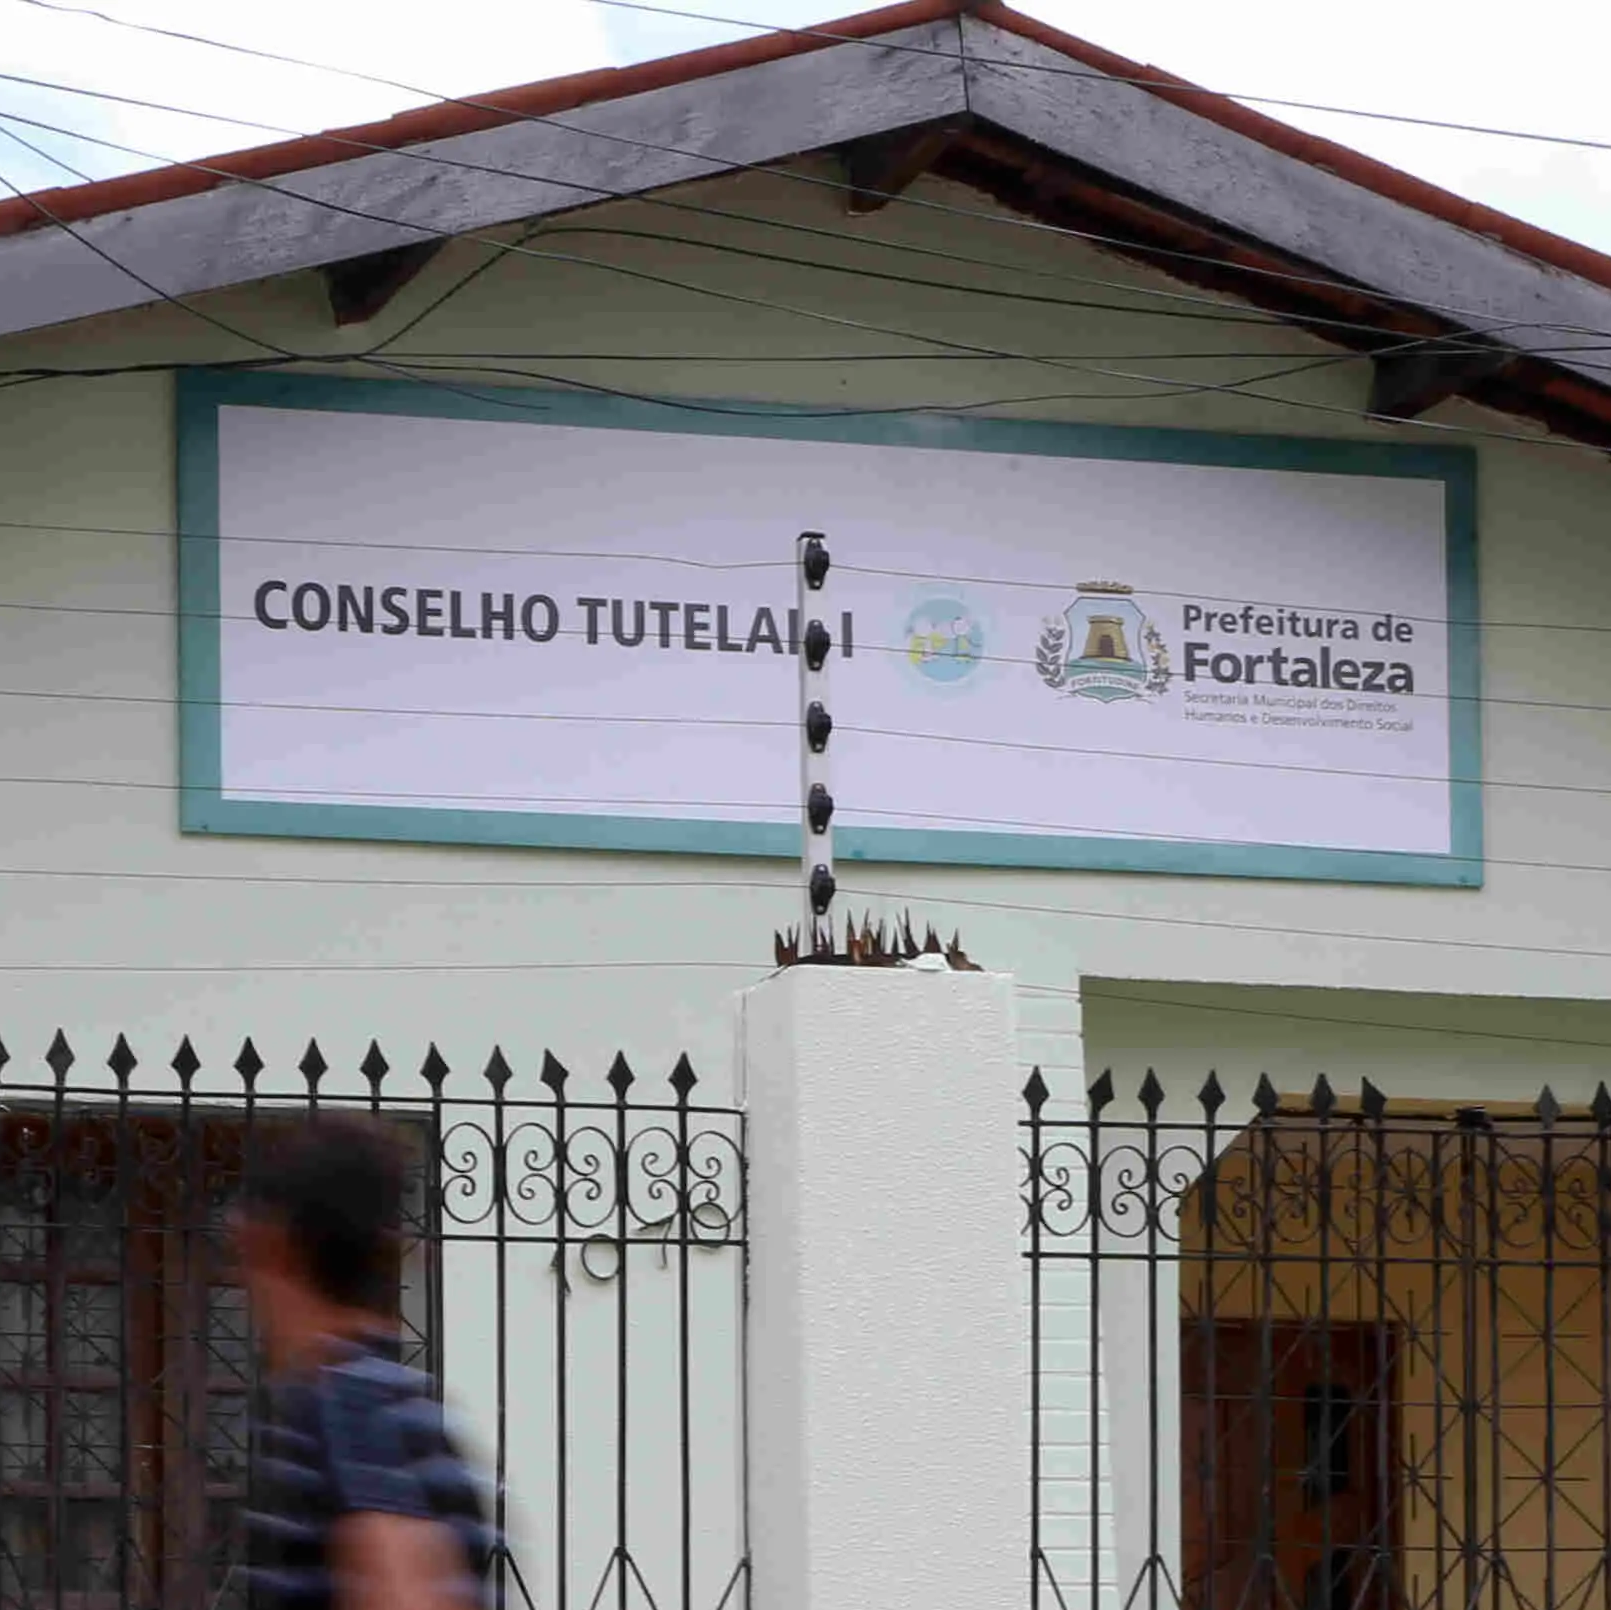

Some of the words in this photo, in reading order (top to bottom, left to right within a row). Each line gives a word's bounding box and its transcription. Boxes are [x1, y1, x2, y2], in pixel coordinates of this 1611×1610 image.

[253, 580, 560, 642] CONSELHO
[576, 597, 800, 655] TUTELA
[1182, 604, 1360, 640] Prefeitura
[1371, 614, 1414, 643] de
[1183, 641, 1415, 696] Fortaleza
[1184, 690, 1249, 705] Secretaria
[1253, 693, 1318, 710] Municipal
[1321, 698, 1344, 710] dos
[1347, 699, 1398, 713] Direitos
[1184, 708, 1247, 724] Humanos
[1376, 718, 1414, 732] Social
